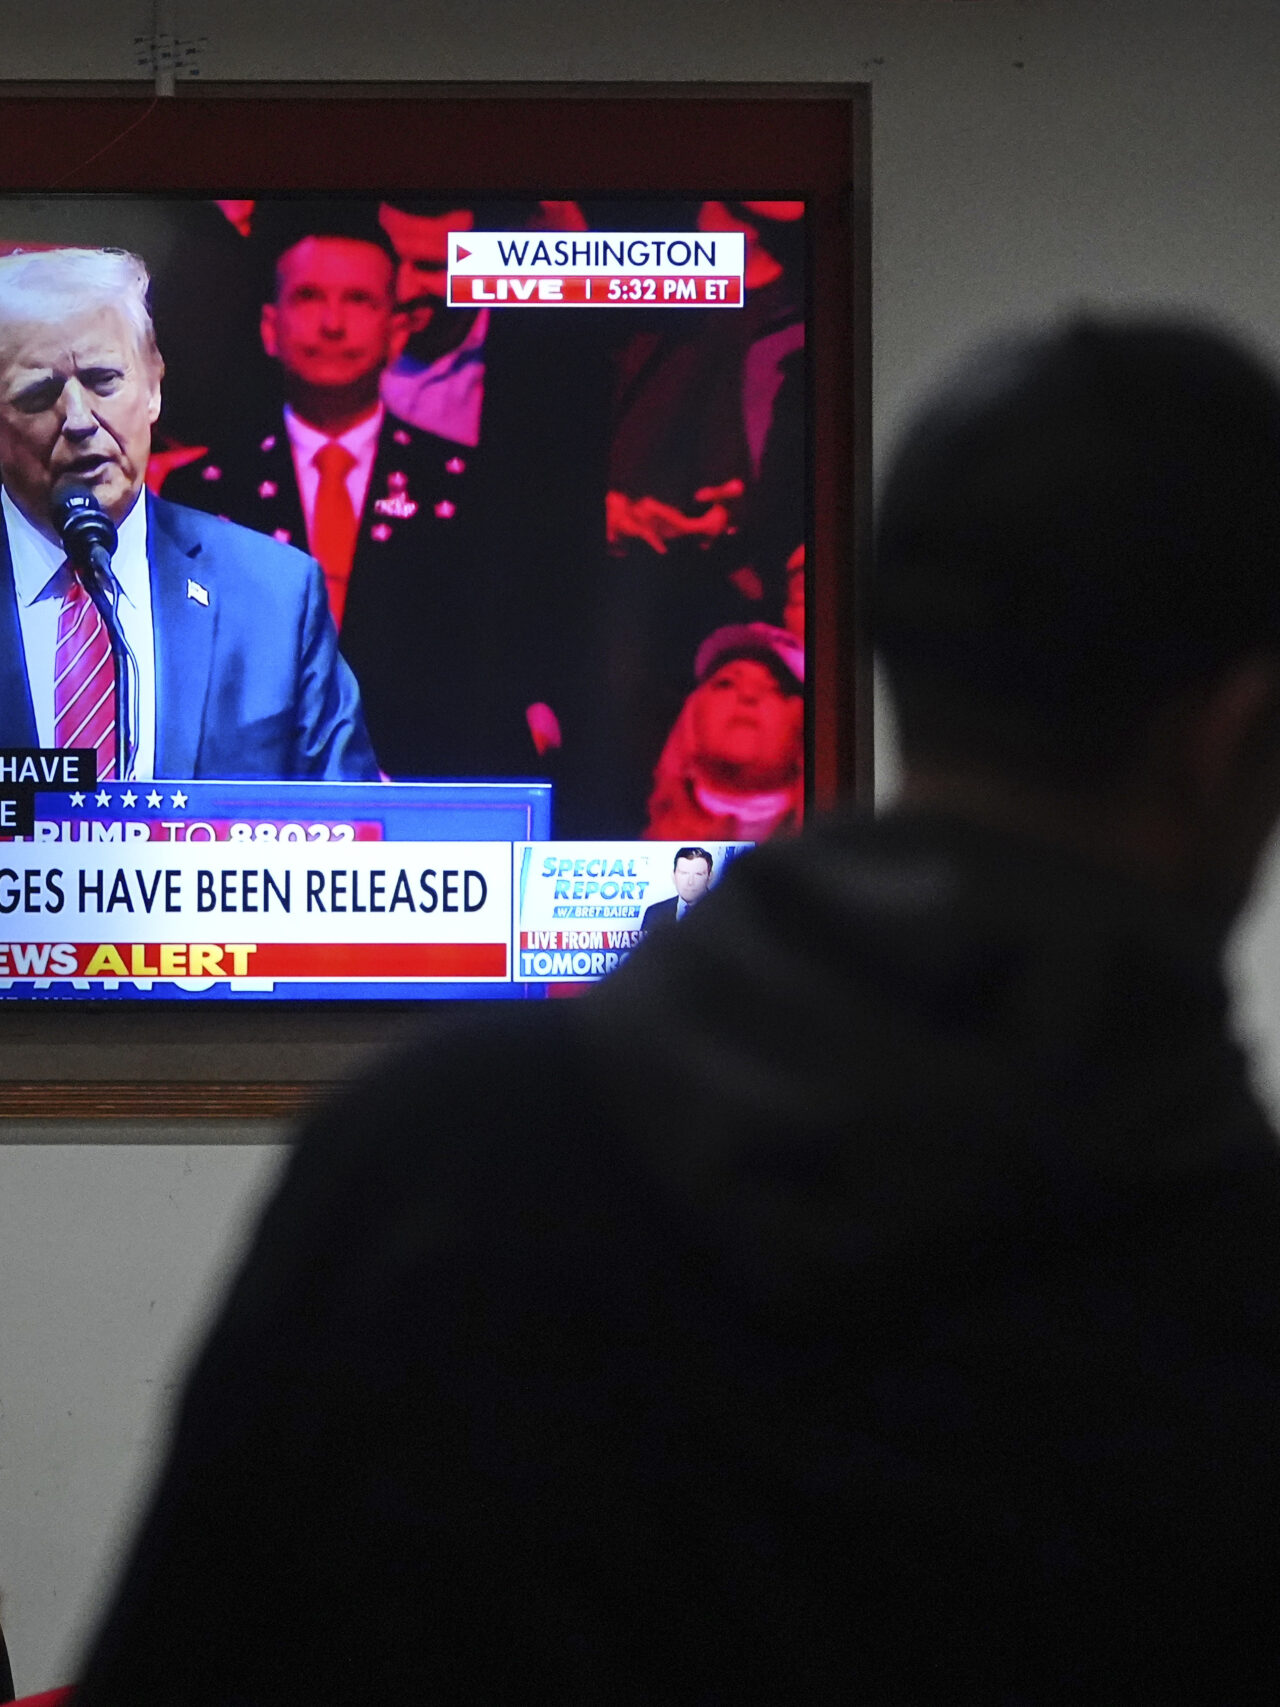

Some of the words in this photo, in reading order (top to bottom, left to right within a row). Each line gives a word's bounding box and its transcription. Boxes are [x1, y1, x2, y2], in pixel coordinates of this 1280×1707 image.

[497, 240, 716, 267] WASHINGTON
[471, 279, 564, 300] LIVE
[607, 279, 656, 301] 5:32
[663, 279, 697, 300] PM
[704, 279, 729, 300] ET
[541, 857, 637, 878] SPECIAL
[79, 868, 182, 913] HAVE
[196, 868, 291, 913] BEEN
[306, 868, 488, 914] RELEASED
[553, 879, 650, 900] REPORT
[527, 931, 558, 950] LIVE
[561, 931, 604, 950] FROM
[83, 943, 257, 976] ALERT
